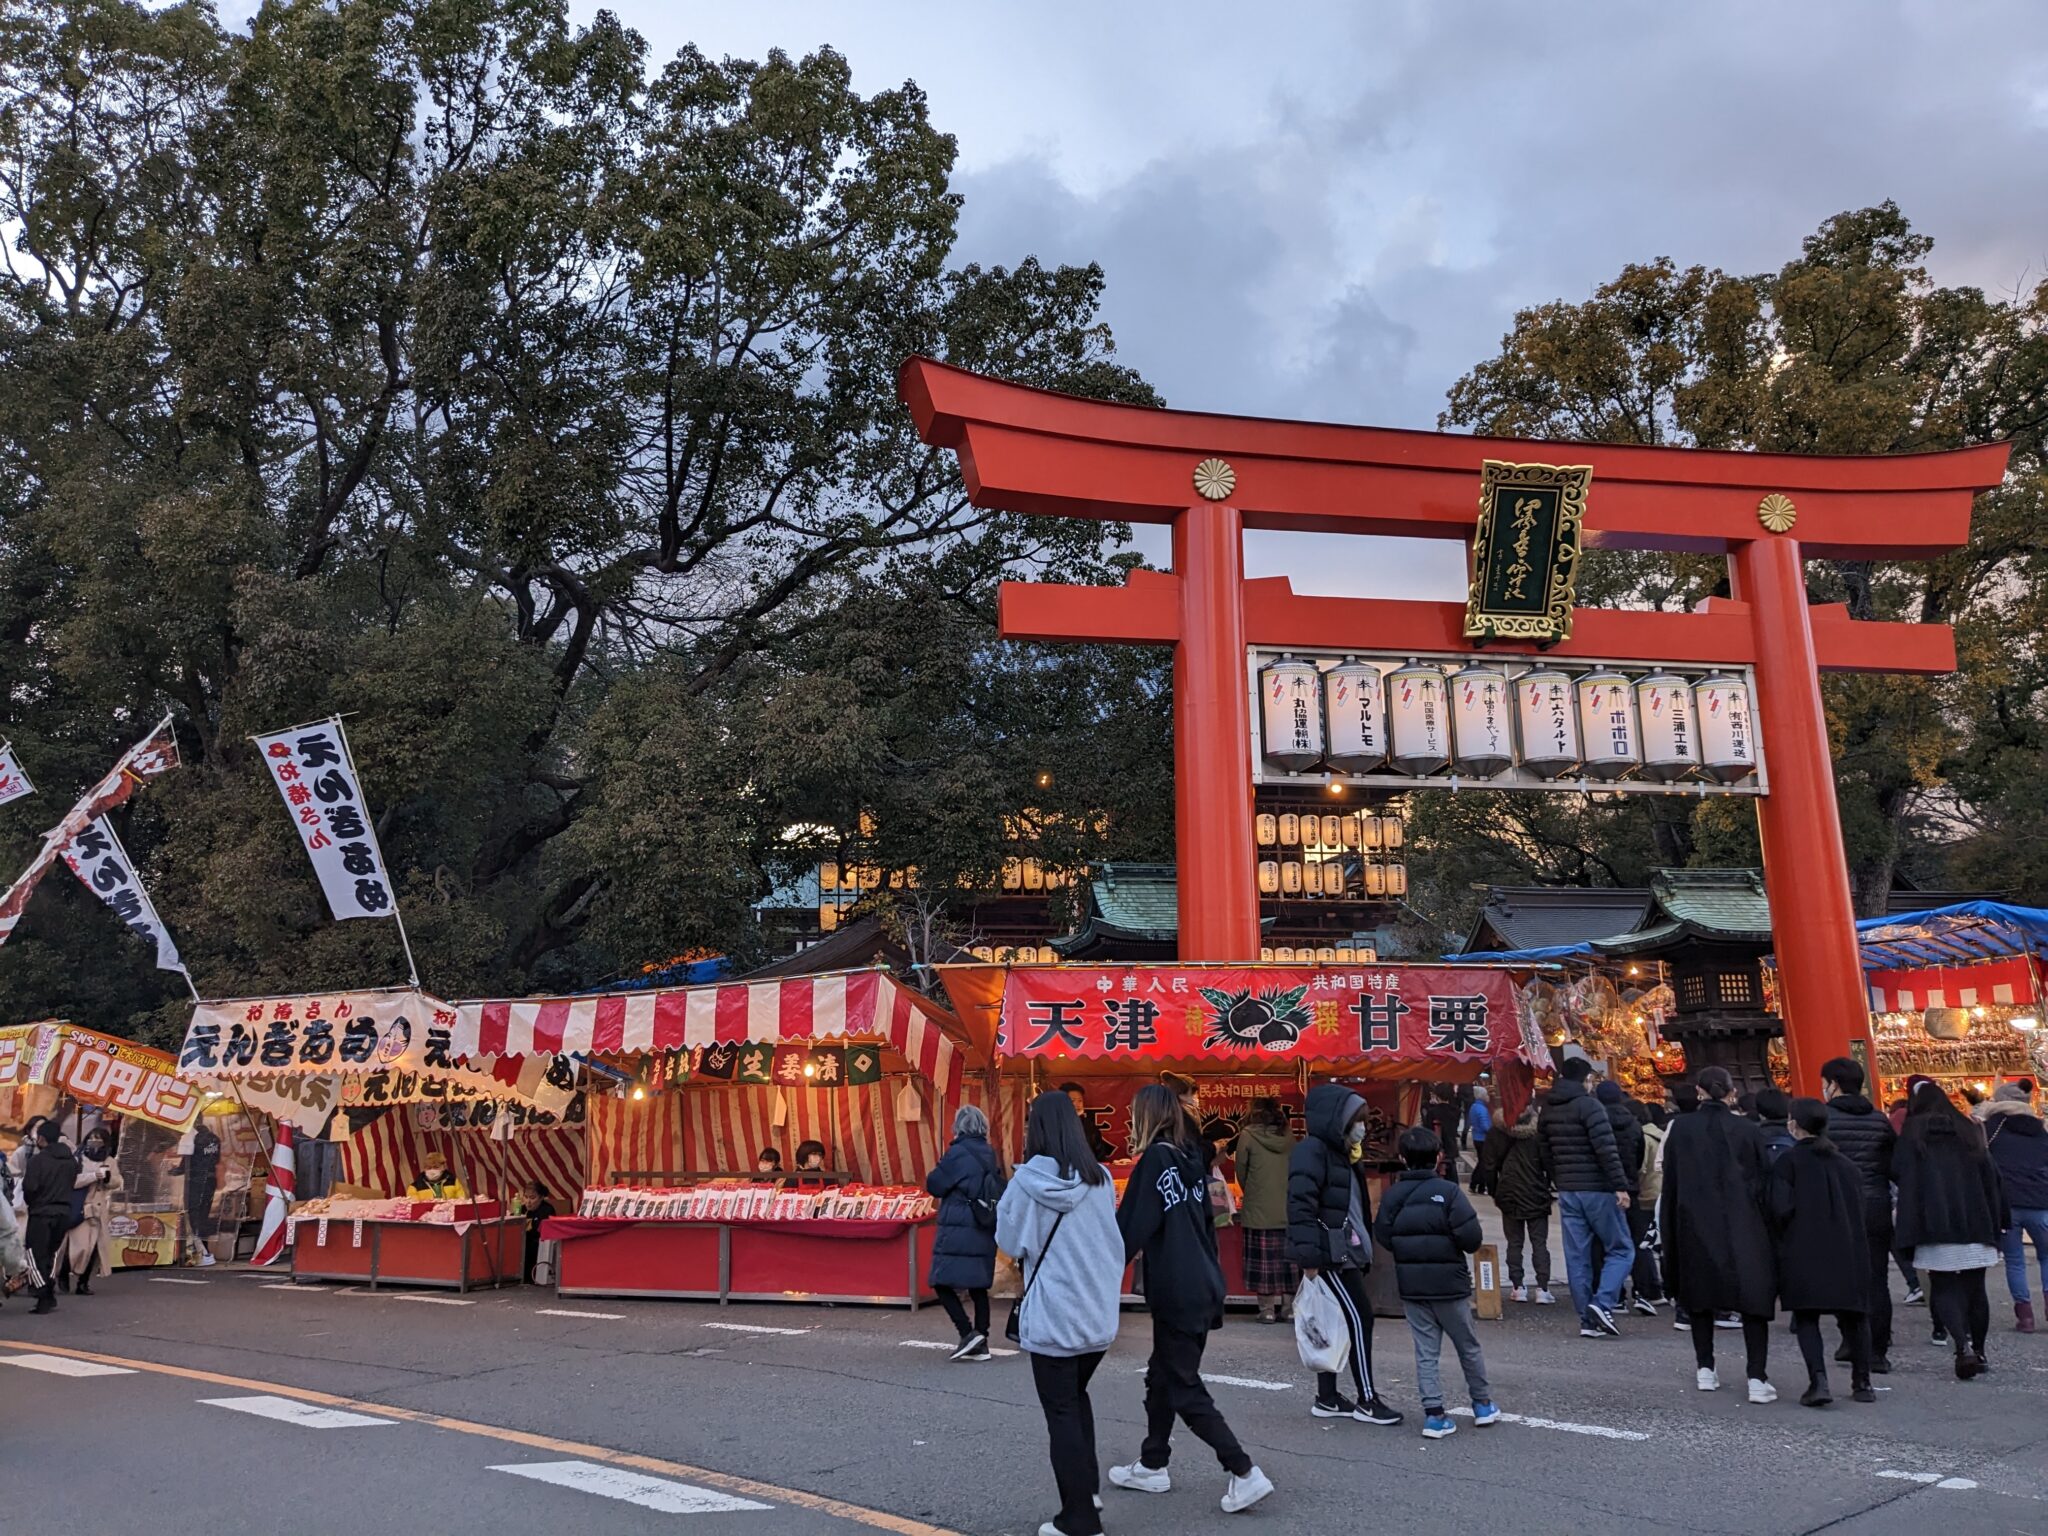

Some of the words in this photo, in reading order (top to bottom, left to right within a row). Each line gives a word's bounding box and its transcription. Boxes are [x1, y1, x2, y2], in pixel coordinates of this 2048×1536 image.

[1358, 697, 1373, 747] マルトモ
[1424, 701, 1437, 751] 四国医療サービス
[1550, 696, 1566, 753] 一六タルト
[1672, 709, 1688, 756] 三浦工業
[277, 761, 332, 849] お椿さん
[296, 733, 389, 912] えんぎあめ
[1097, 976, 1189, 993] 中華人民
[1312, 974, 1400, 991] 共和国特産
[246, 1000, 352, 1021] お椿さん
[1023, 998, 1162, 1051] 天津
[1348, 993, 1490, 1053] 甘栗
[70, 1030, 95, 1047] SNS
[181, 1016, 379, 1068] えんぎあめ
[57, 1042, 198, 1124] 10円パン
